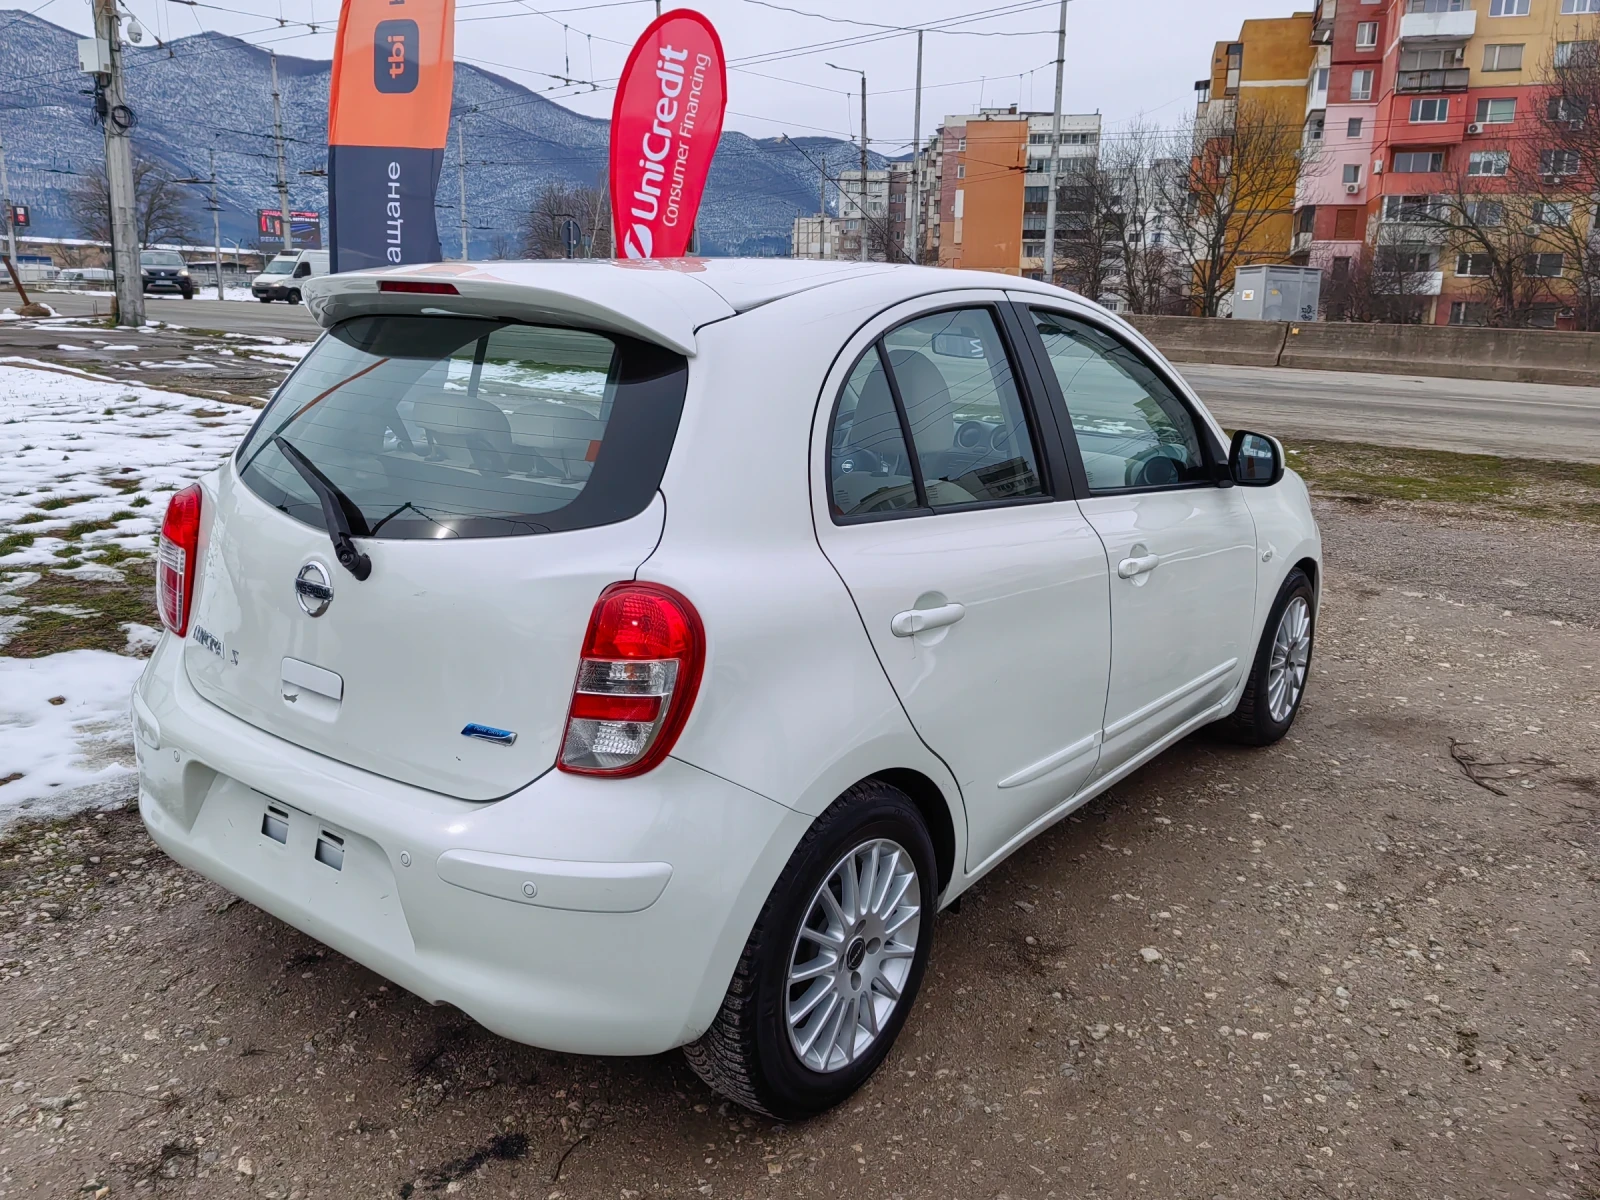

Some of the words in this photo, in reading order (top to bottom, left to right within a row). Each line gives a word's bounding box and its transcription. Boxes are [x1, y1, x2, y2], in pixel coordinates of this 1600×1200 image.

[387, 35, 405, 79] tbi
[631, 44, 688, 220] UniCredit
[663, 140, 690, 227] Consumer
[679, 53, 712, 139] Financing
